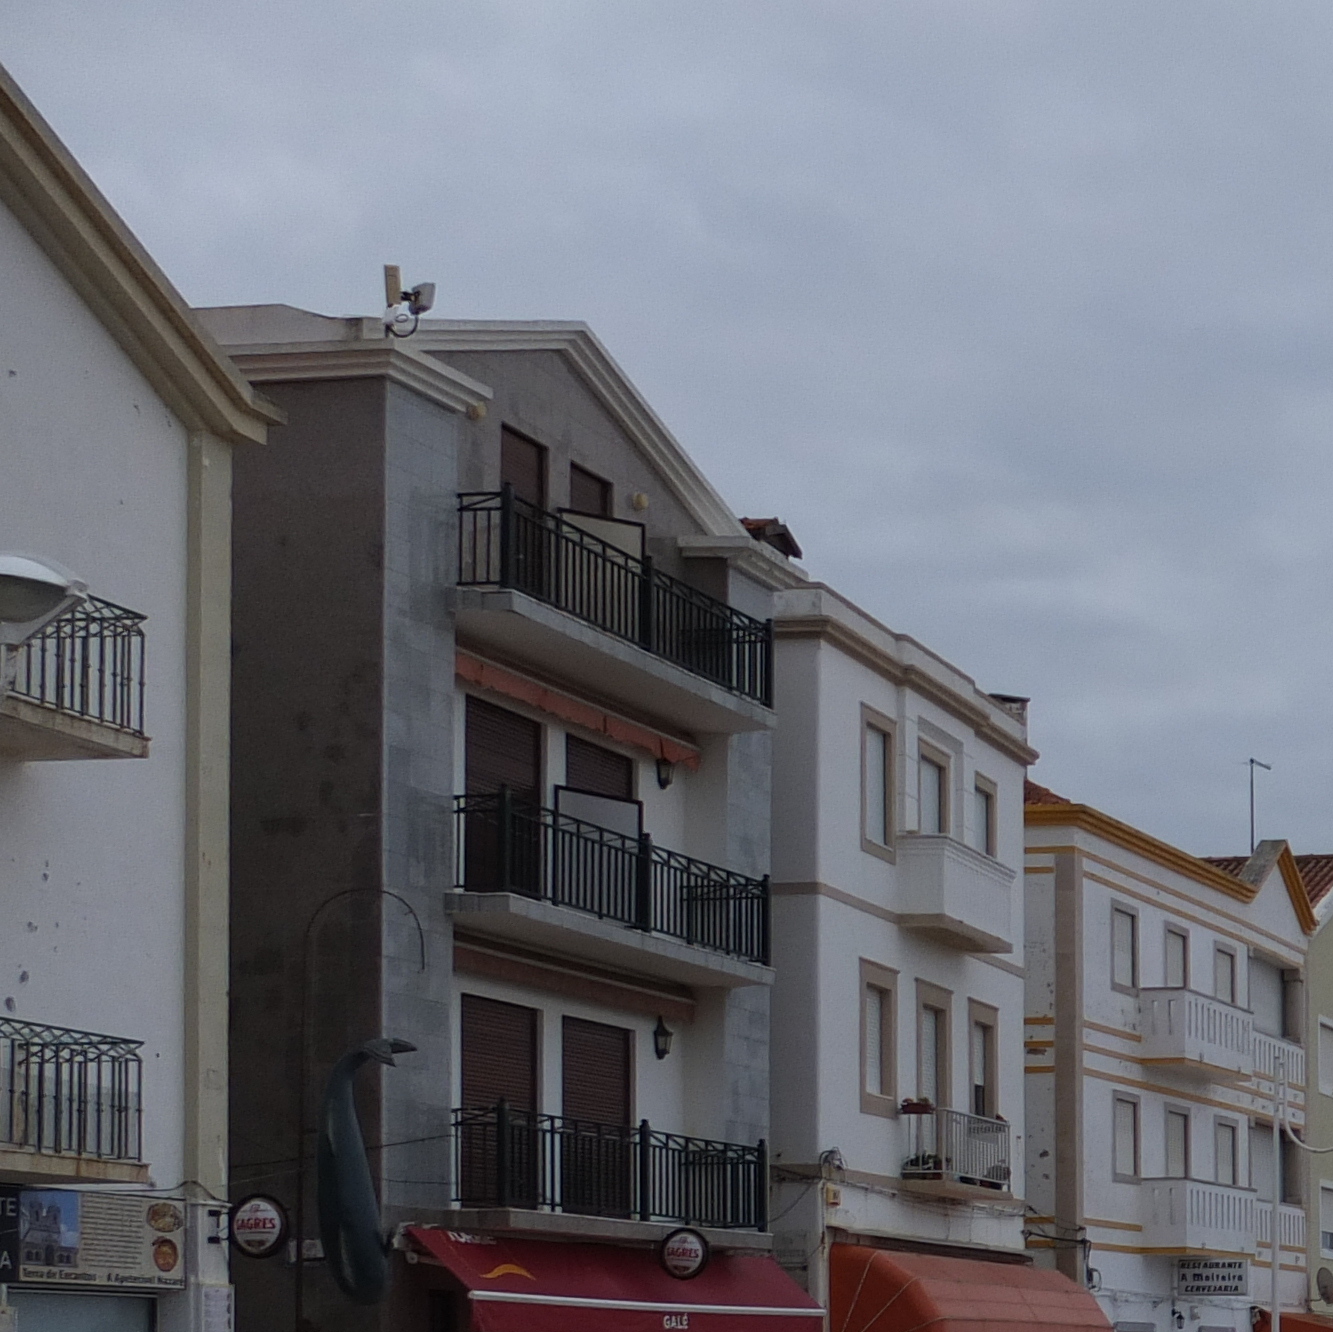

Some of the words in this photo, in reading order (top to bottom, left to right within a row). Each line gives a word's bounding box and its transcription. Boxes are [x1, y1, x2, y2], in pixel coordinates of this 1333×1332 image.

[236, 1217, 276, 1230] SAGRES
[666, 1247, 700, 1259] SAGRES
[1180, 1261, 1243, 1269] RESTAURANTE
[1184, 1285, 1239, 1293] CERVEJARIA
